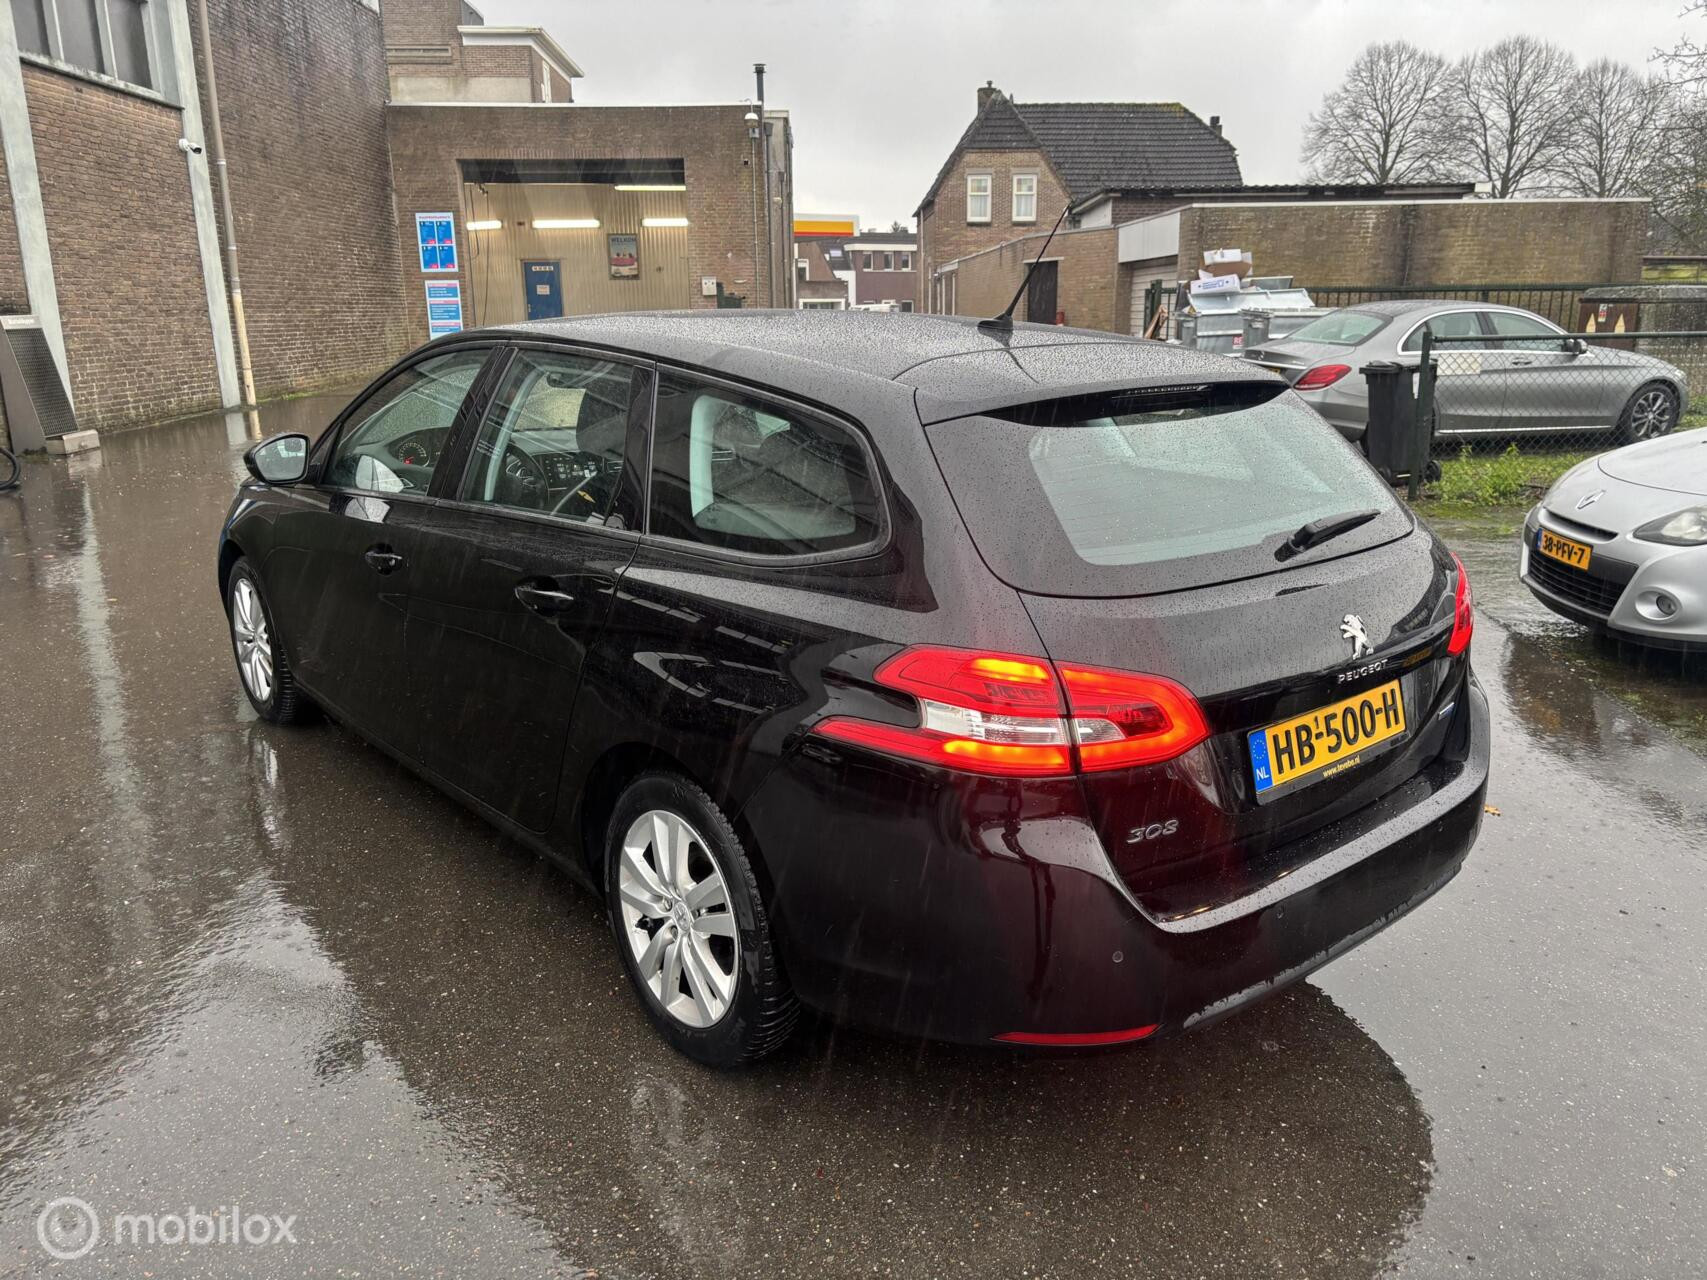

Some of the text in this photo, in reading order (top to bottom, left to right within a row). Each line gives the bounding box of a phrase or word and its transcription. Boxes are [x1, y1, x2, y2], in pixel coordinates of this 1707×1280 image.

[1542, 534, 1585, 564] 38-PFV-7
[1338, 659, 1388, 684] PEUGEOT
[1273, 688, 1400, 775] HB-500-H
[1256, 768, 1270, 781] NL
[1126, 819, 1179, 844] 308
